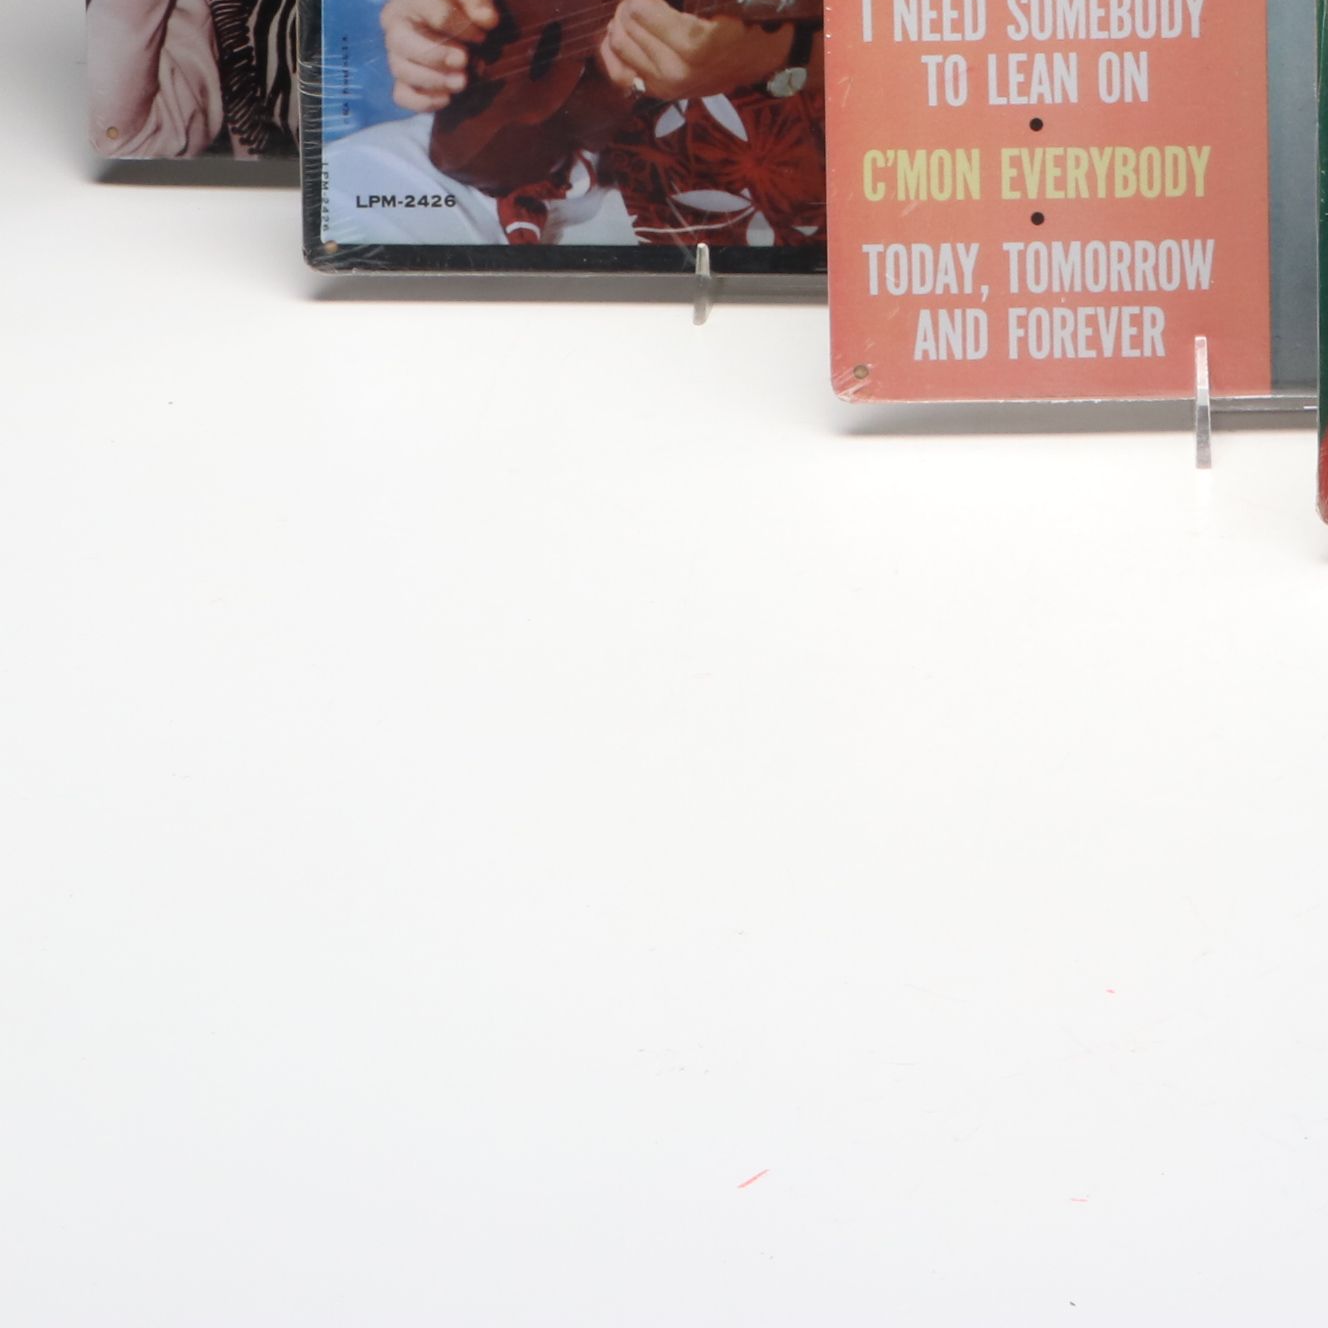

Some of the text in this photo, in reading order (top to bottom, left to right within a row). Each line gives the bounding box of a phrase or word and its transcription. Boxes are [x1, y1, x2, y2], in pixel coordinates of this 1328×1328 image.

[921, 51, 1150, 106] TO LEAN ON
[862, 145, 1212, 202] C'MON EVERYBODY
[355, 195, 457, 208] LPM-2426
[862, 239, 1215, 302] TODAY, TOMORROW
[913, 306, 1166, 361] AND FOREVER
